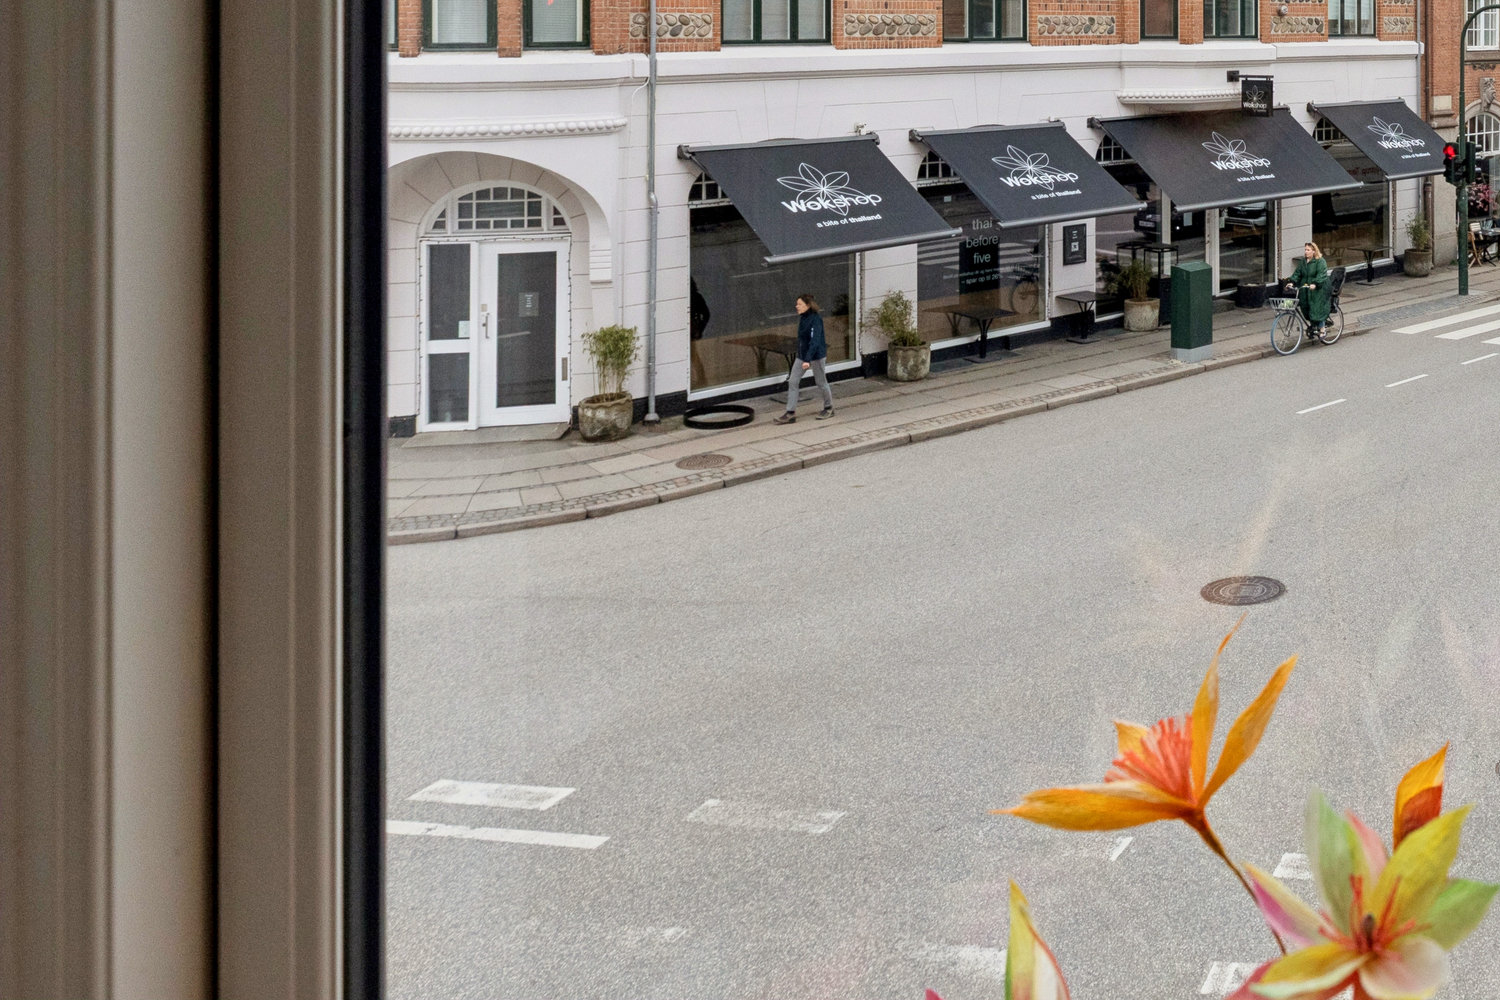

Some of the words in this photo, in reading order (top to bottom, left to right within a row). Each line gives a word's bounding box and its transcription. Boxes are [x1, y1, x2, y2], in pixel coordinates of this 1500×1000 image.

[1377, 139, 1425, 149] Wokshop
[1210, 158, 1271, 170] Wokshop
[1000, 172, 1079, 187] Wokshop
[781, 194, 882, 213] Wokshop
[822, 219, 839, 227] bite
[848, 213, 882, 224] thailand
[972, 217, 993, 231] thai
[965, 235, 999, 249] before
[973, 252, 992, 265] five
